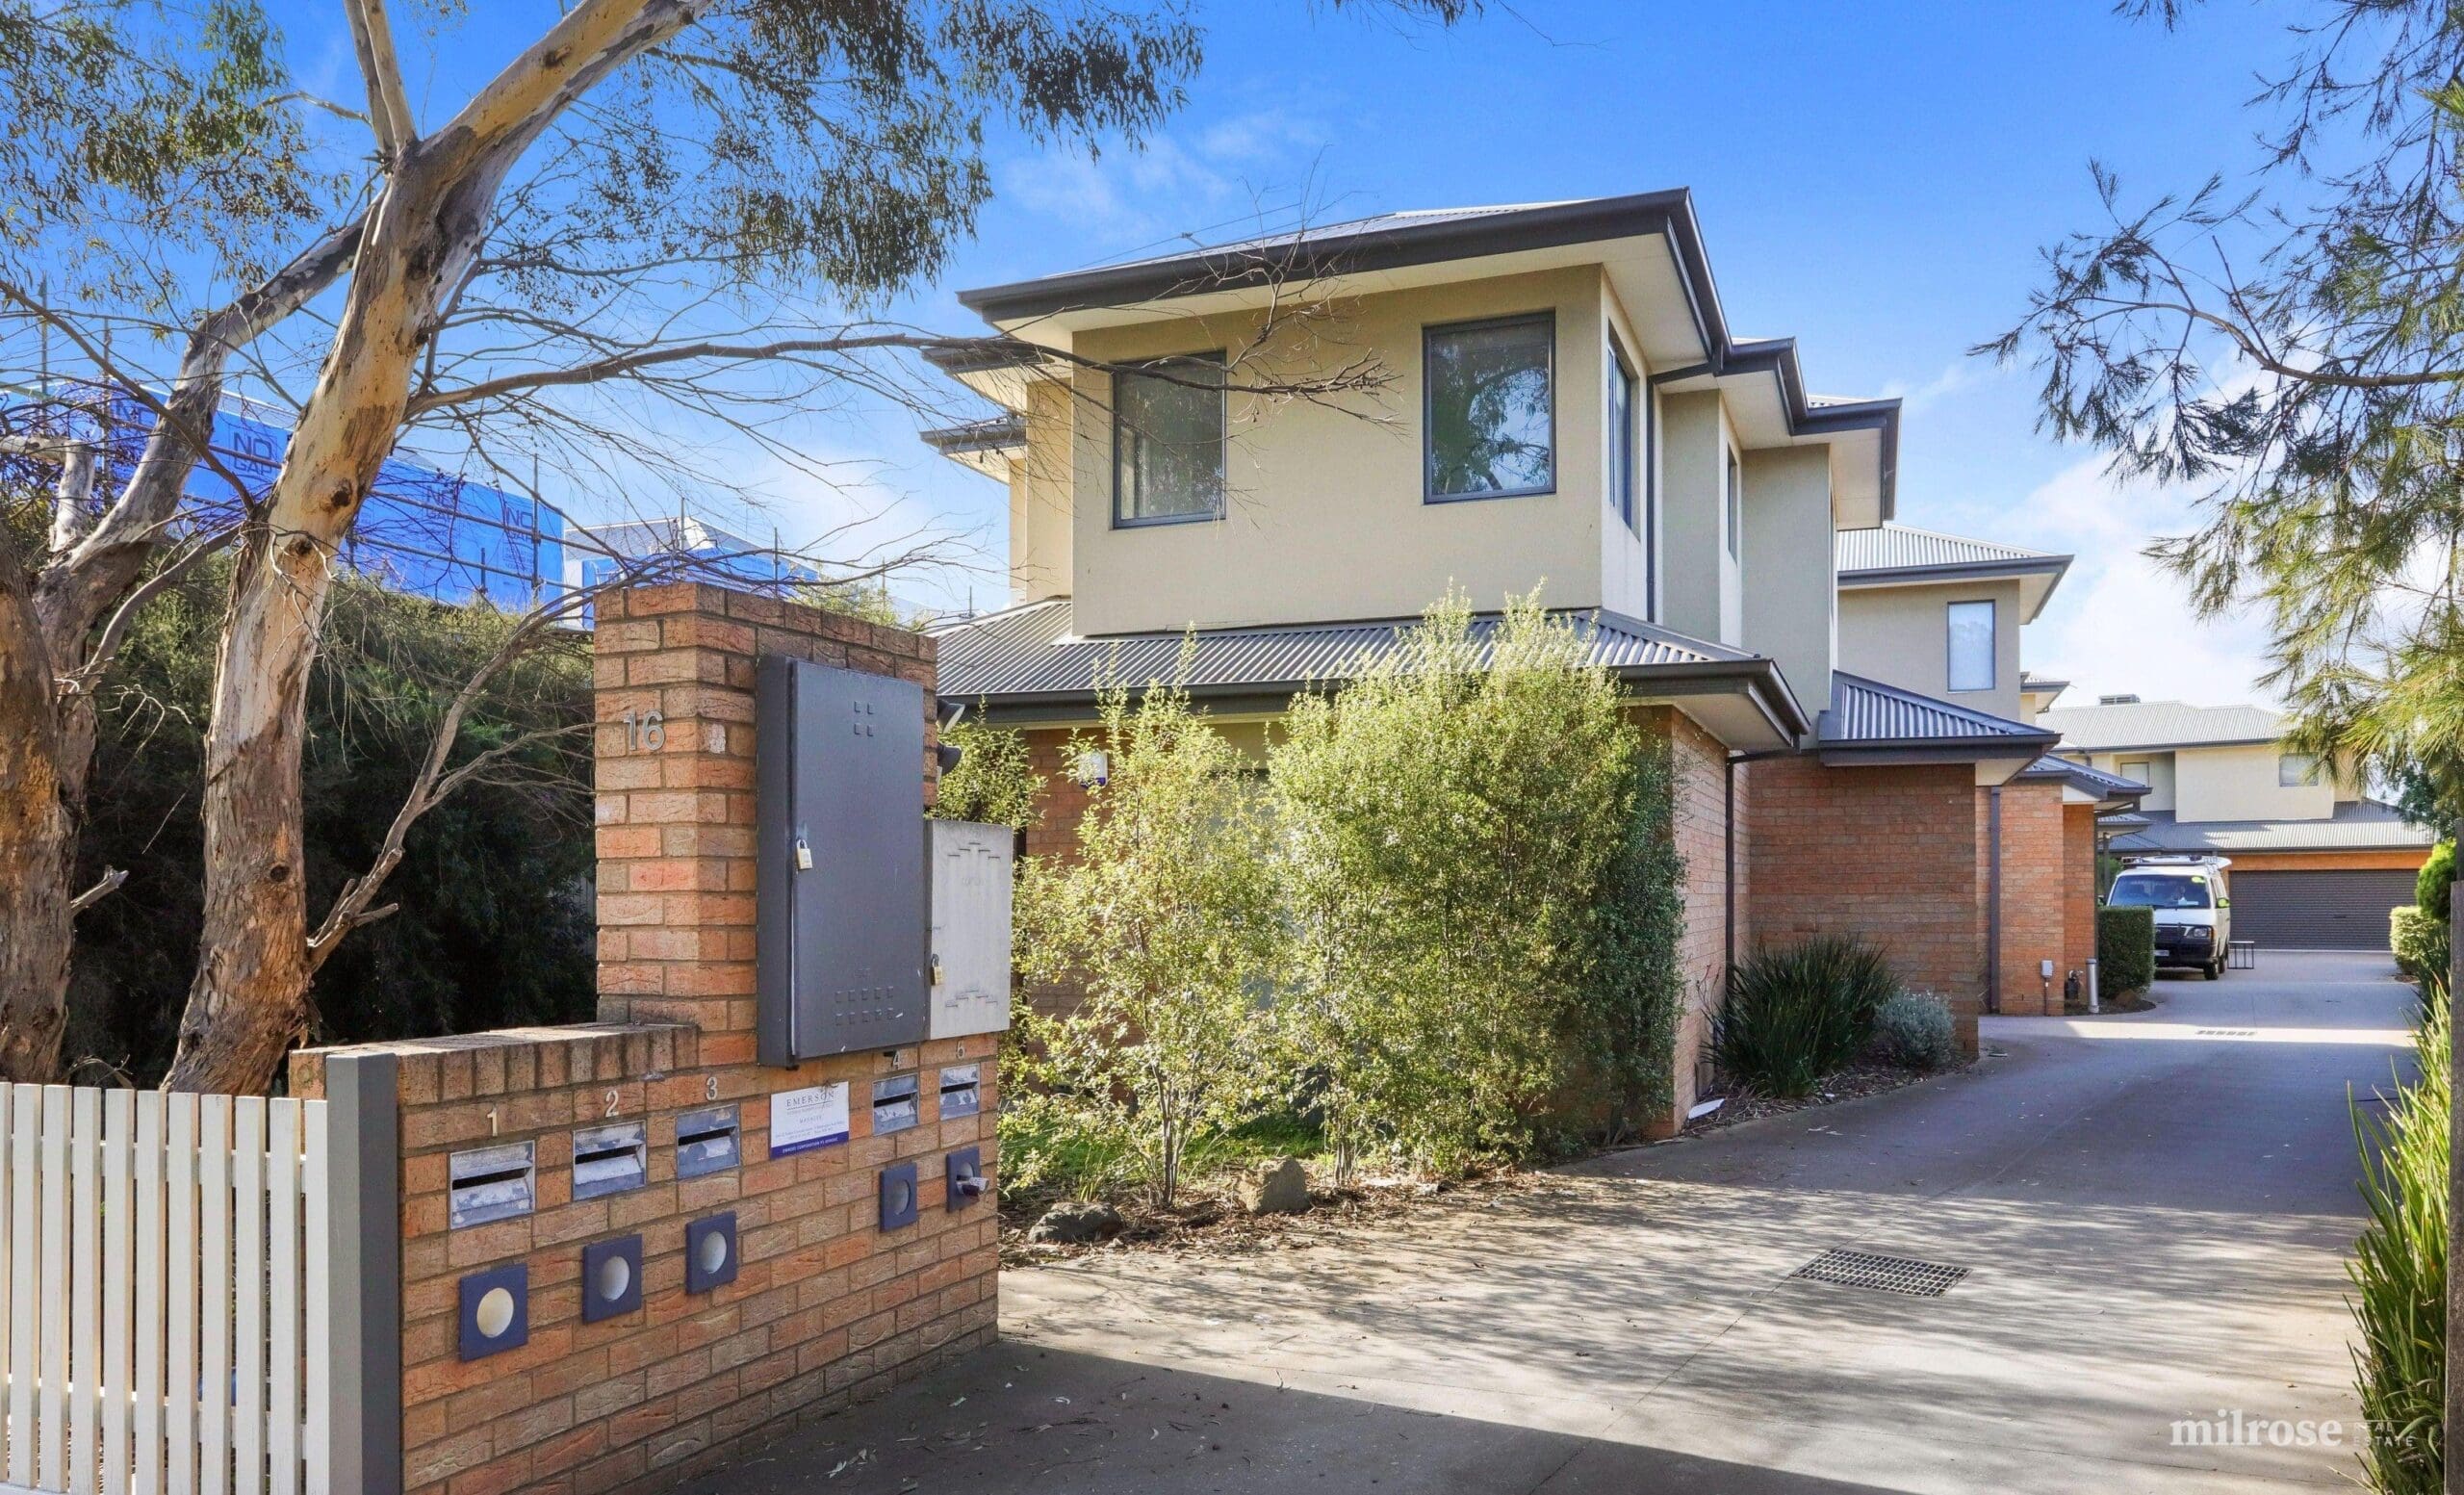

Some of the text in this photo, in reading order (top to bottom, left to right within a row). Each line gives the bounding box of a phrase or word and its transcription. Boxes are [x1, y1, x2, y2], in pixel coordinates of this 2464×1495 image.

[234, 432, 272, 459] NO
[506, 506, 535, 528] NO
[624, 709, 665, 751] 16
[891, 1049, 901, 1070] 4
[706, 1076, 718, 1101] 3
[786, 1090, 834, 1107] EMERSON
[605, 1090, 619, 1118] 2
[487, 1107, 499, 1137] 1
